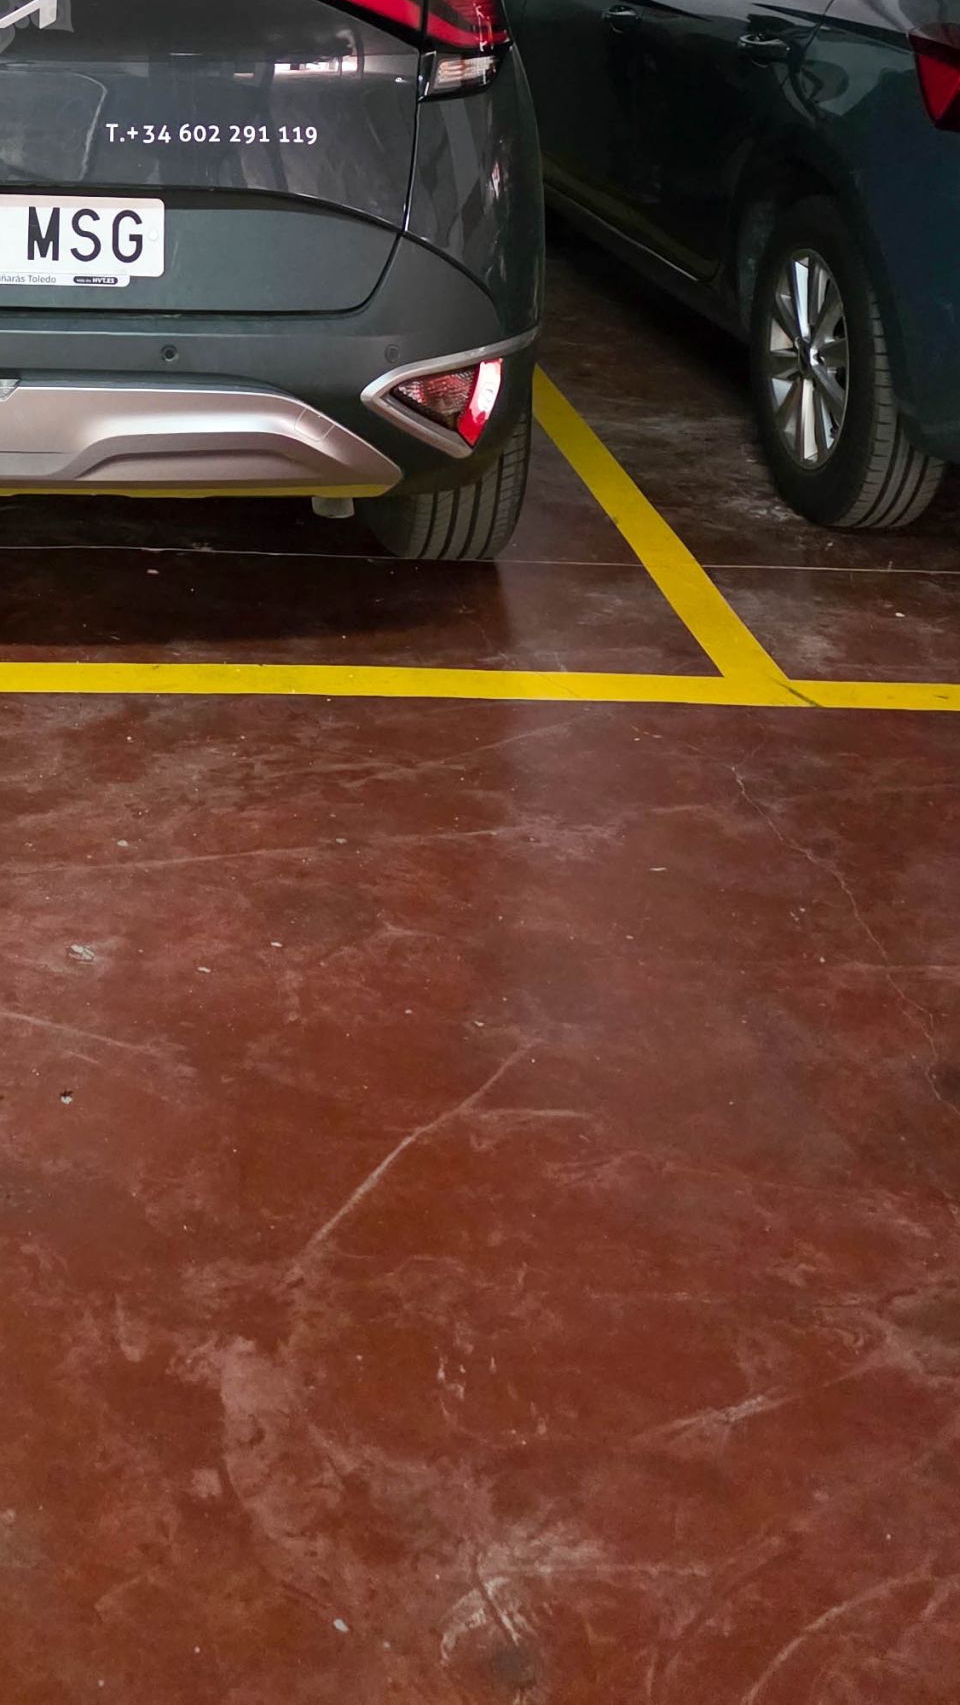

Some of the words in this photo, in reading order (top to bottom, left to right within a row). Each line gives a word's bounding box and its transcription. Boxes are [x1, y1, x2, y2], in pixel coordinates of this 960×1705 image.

[179, 123, 221, 144] 602
[229, 124, 270, 144] 291
[278, 125, 318, 145] 119
[27, 206, 143, 264] MSG
[27, 274, 57, 285] Toledo
